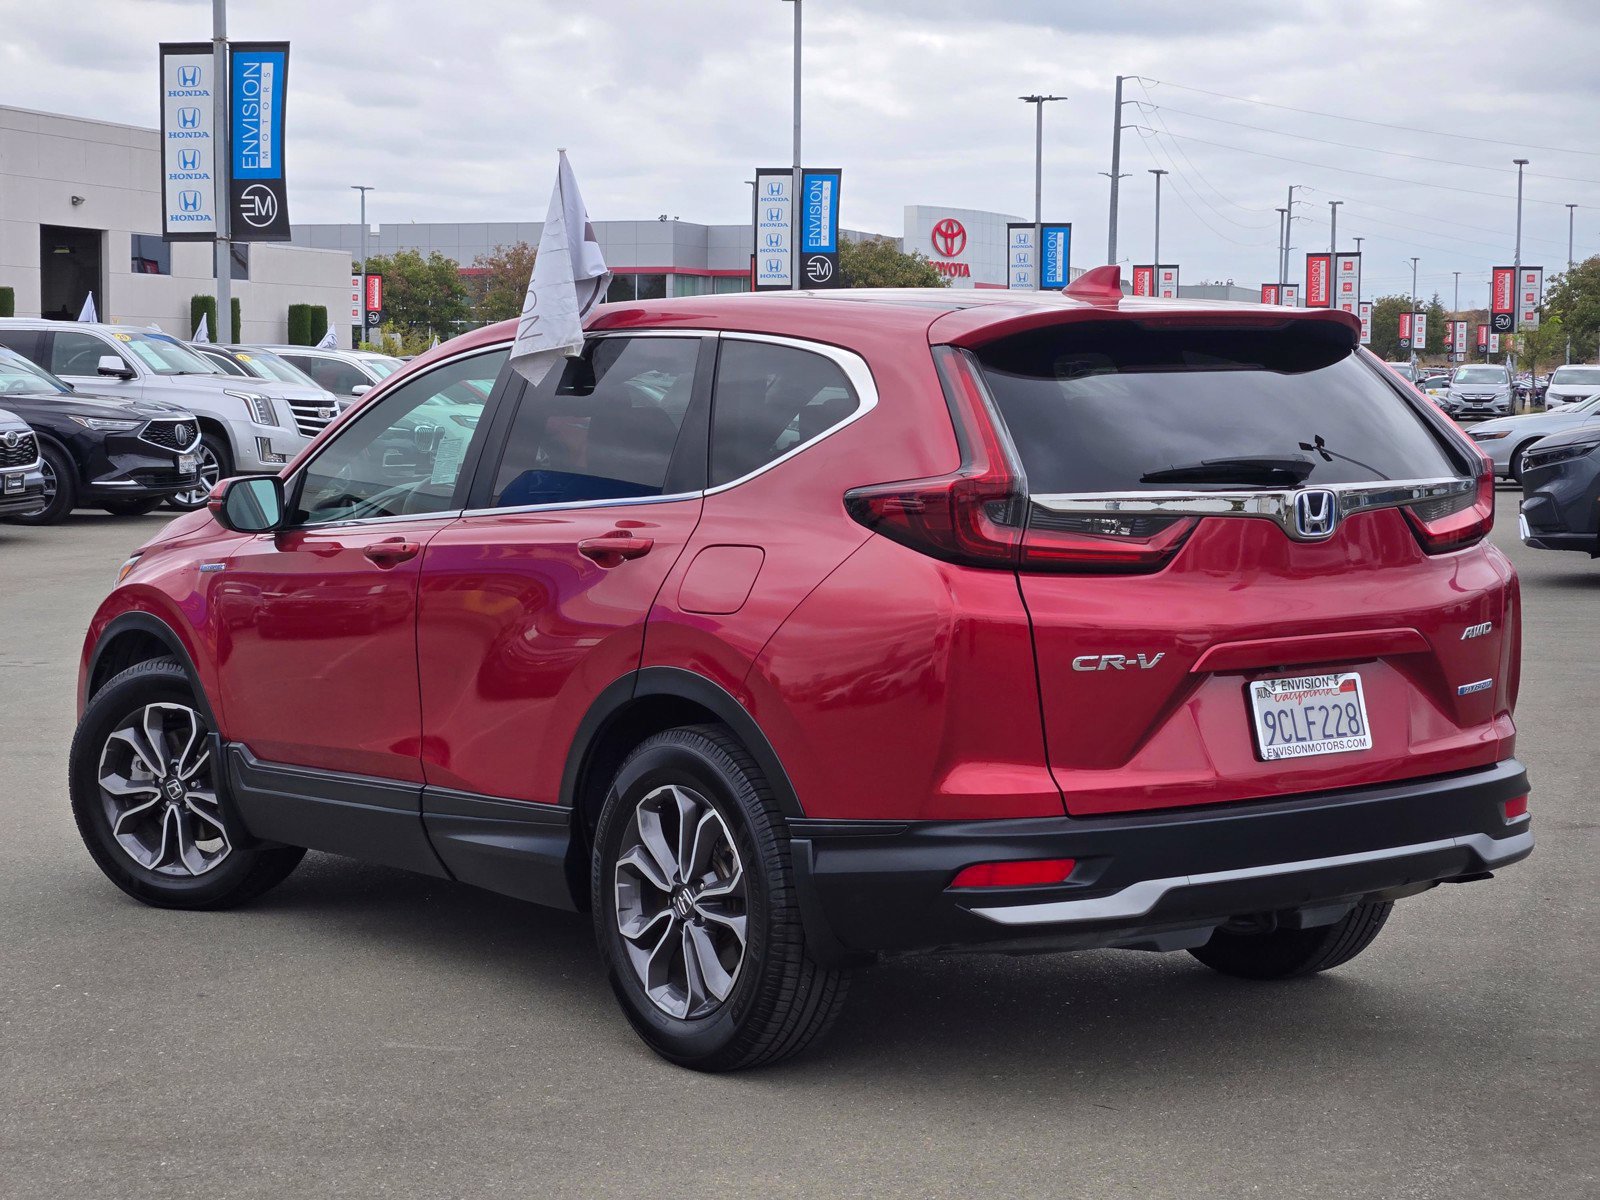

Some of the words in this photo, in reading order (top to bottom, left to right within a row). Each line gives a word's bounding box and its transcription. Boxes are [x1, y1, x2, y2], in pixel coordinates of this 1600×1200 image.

[168, 131, 210, 139] HONDA
[242, 62, 260, 169] ENVISION
[262, 72, 271, 160] MOTORS
[170, 214, 212, 222] HONDA
[808, 180, 822, 247] ENVISION
[1046, 231, 1057, 283] ENVISION
[1311, 260, 1320, 302] ENVISION
[1072, 652, 1166, 671] CR-V
[1281, 677, 1329, 691] ENVISION
[1263, 702, 1360, 746] 9CLF228
[1266, 738, 1367, 758] ENVISIONMOTORS.COM
